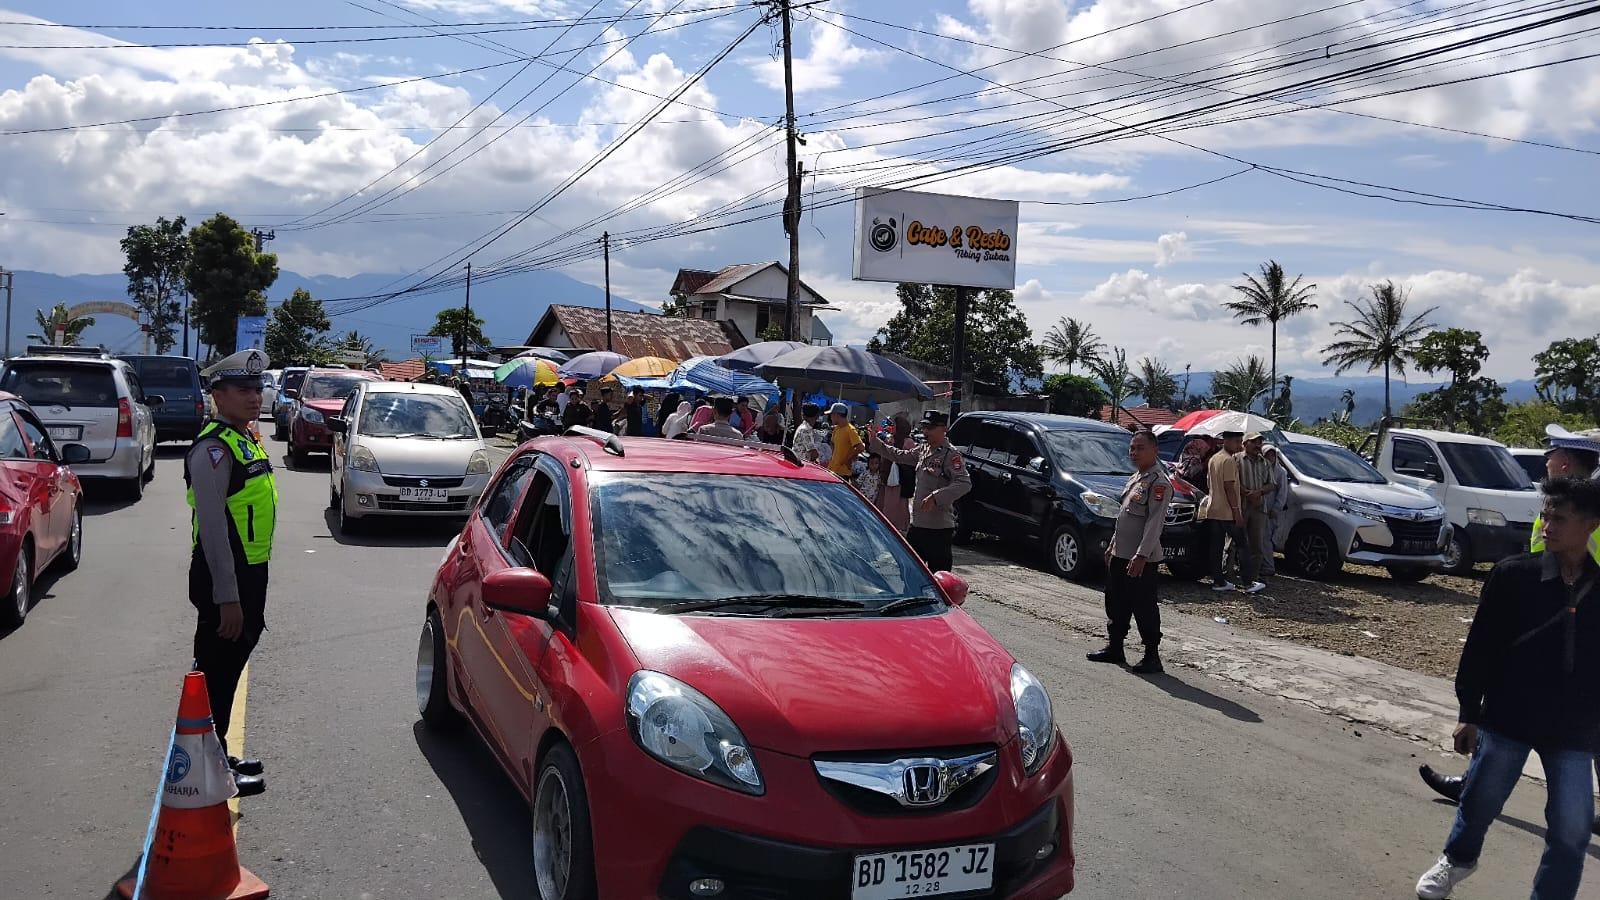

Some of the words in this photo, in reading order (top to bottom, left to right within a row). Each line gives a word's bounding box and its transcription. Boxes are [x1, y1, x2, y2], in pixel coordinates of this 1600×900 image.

[907, 220, 947, 248] Cafe
[950, 225, 963, 249] &
[966, 225, 1011, 251] Resto
[983, 250, 1010, 262] Suban
[401, 487, 411, 496] BD
[414, 488, 433, 497] 1773
[437, 489, 447, 498] LJ
[858, 857, 886, 888] BD
[895, 851, 950, 882] 1582
[962, 847, 989, 874] JZ
